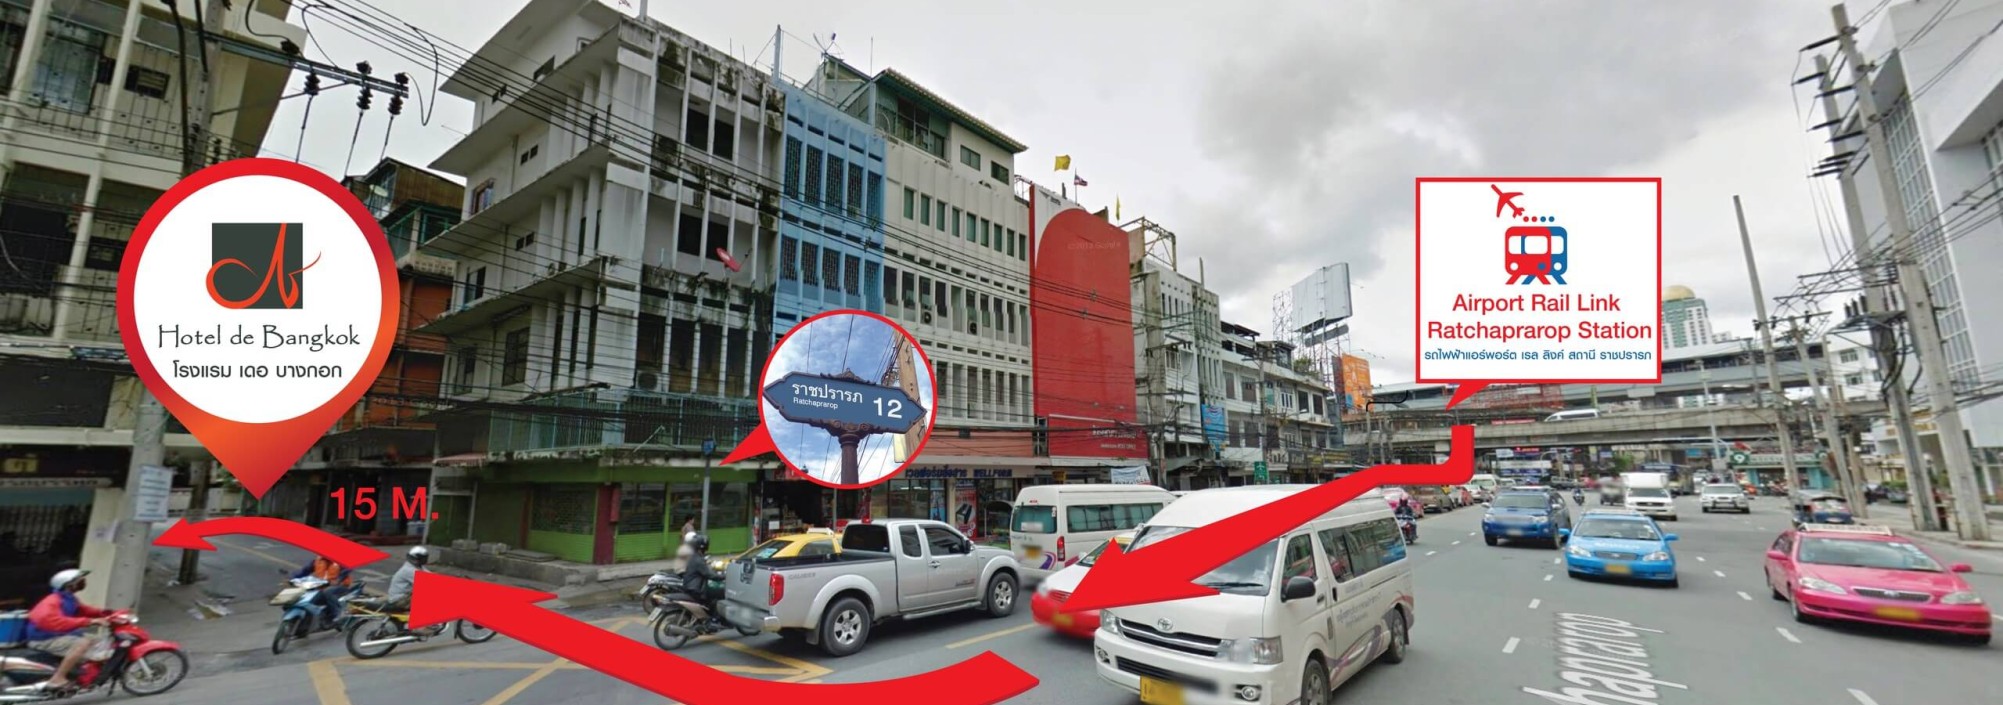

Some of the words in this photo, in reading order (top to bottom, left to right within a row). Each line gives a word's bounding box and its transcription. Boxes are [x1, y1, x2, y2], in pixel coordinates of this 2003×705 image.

[792, 383, 863, 404] ราชปรารภ
[873, 397, 903, 419] 12
[793, 397, 839, 410] Ratchaprarop
